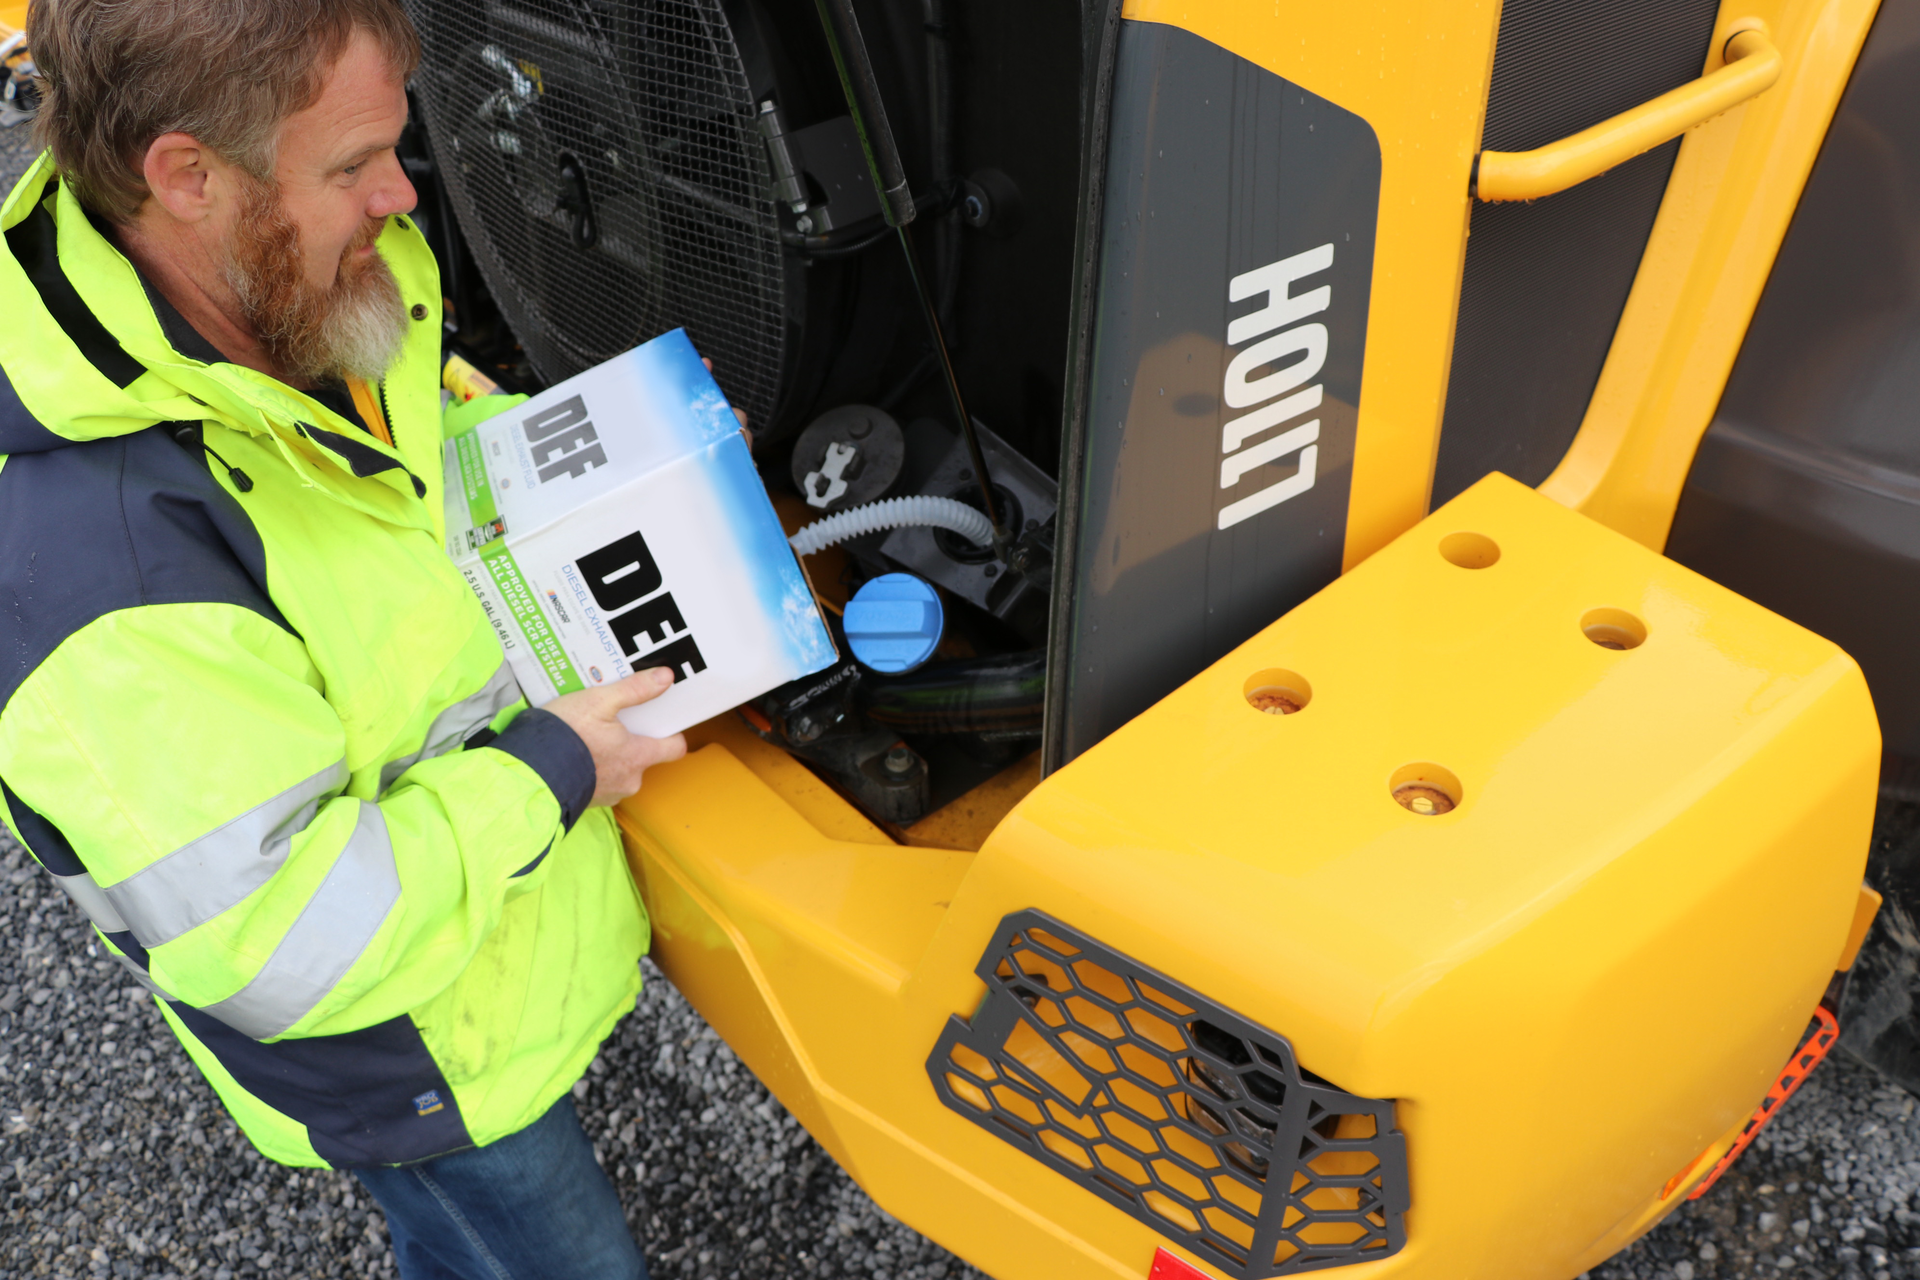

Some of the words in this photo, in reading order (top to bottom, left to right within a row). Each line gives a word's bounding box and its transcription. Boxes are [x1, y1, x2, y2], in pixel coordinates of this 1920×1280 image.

[522, 393, 608, 484] DEF
[1217, 242, 1334, 530] L110H
[463, 569, 477, 583] 2.5
[481, 600, 495, 619] GAL.
[491, 618, 510, 641] (9.46
[504, 640, 516, 650] L)
[488, 559, 504, 580] ALL
[501, 581, 526, 620] DIESEL
[522, 620, 540, 641] SCR
[535, 641, 566, 687] SYSTEMS
[498, 555, 535, 613] APPROVED
[531, 614, 549, 636] FOR
[544, 637, 561, 658] USE
[556, 658, 568, 670] IN
[551, 597, 571, 623] NASCAR
[561, 564, 588, 606] DIESEL
[584, 606, 619, 657] EXHAUST
[612, 658, 628, 679] FLU
[575, 530, 708, 685] DEF
